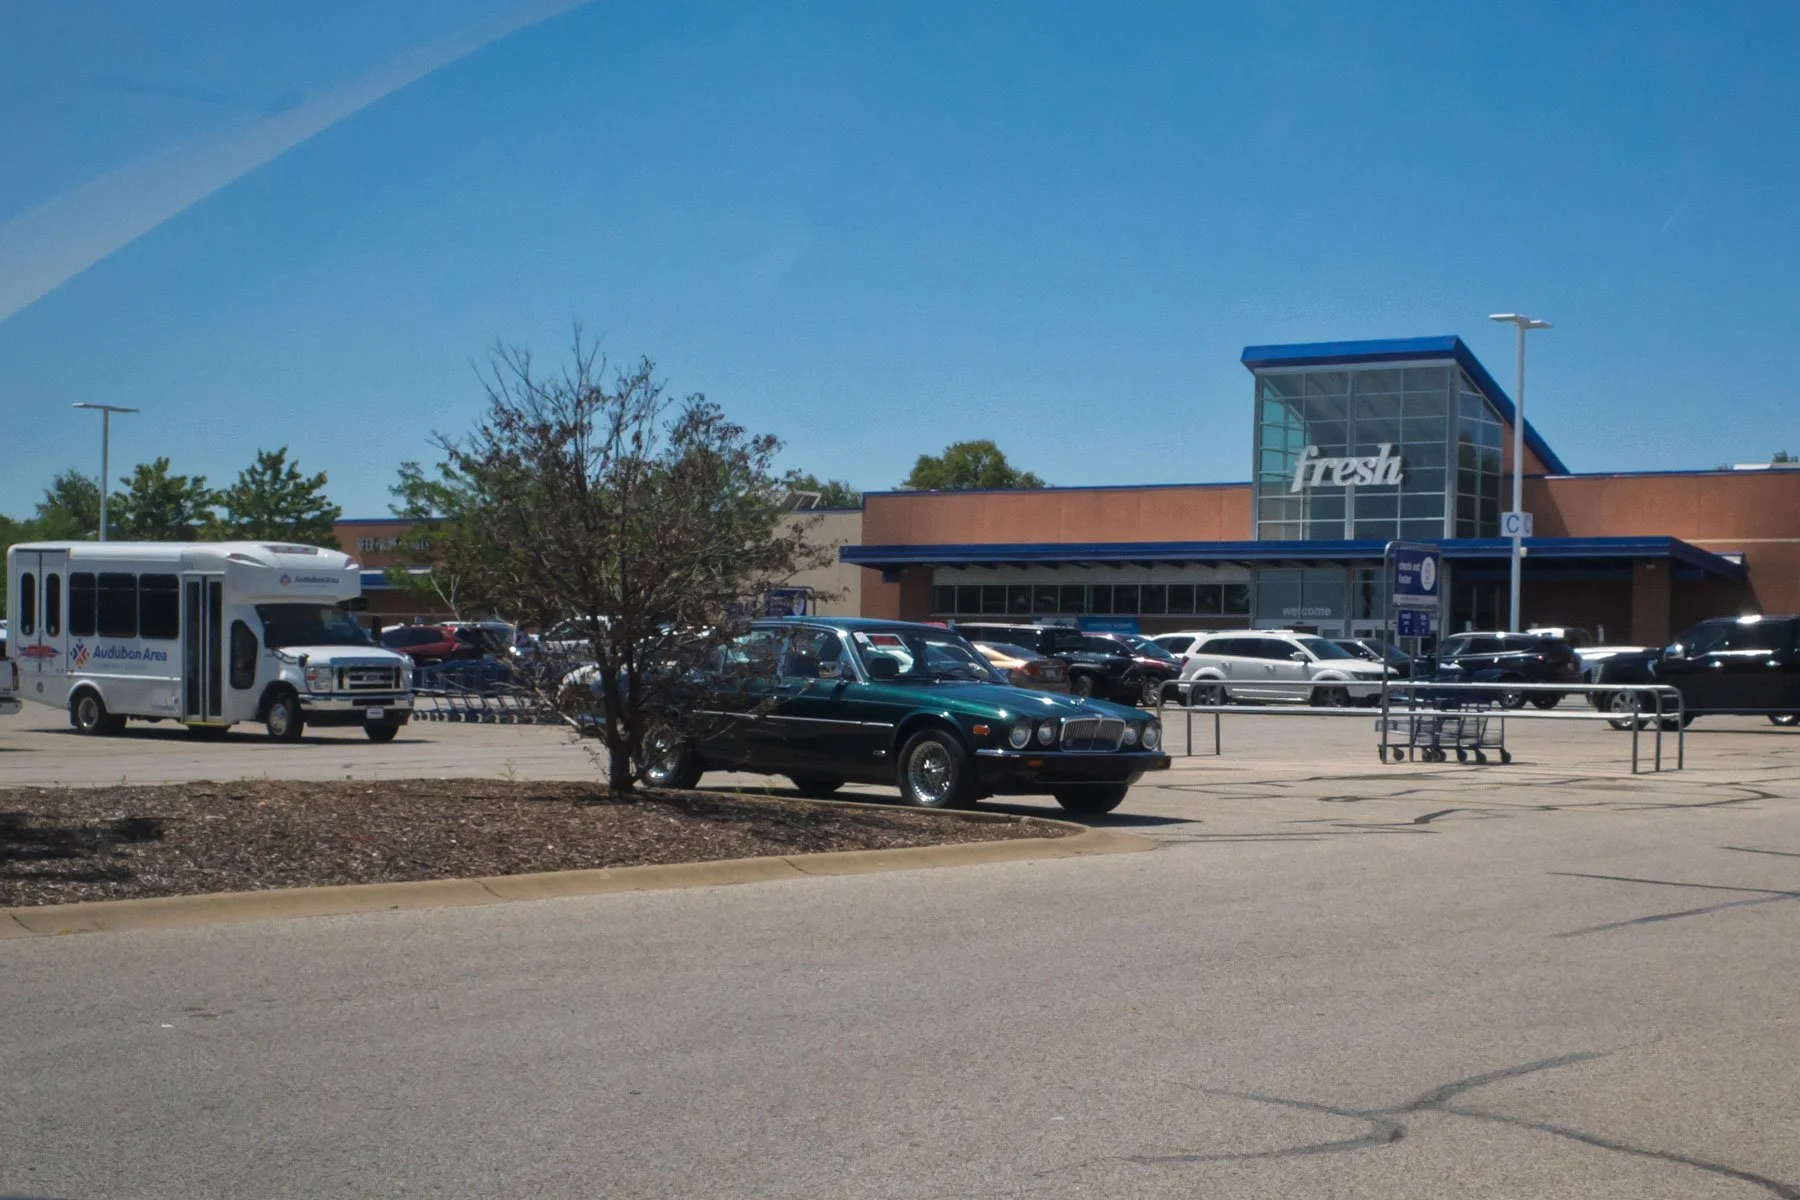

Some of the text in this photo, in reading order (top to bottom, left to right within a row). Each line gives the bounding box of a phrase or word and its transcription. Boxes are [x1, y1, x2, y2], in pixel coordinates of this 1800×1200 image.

[1290, 443, 1404, 492] fresh
[1506, 514, 1520, 533] C
[1282, 606, 1332, 616] welcome
[93, 645, 168, 661] Audubon Area
